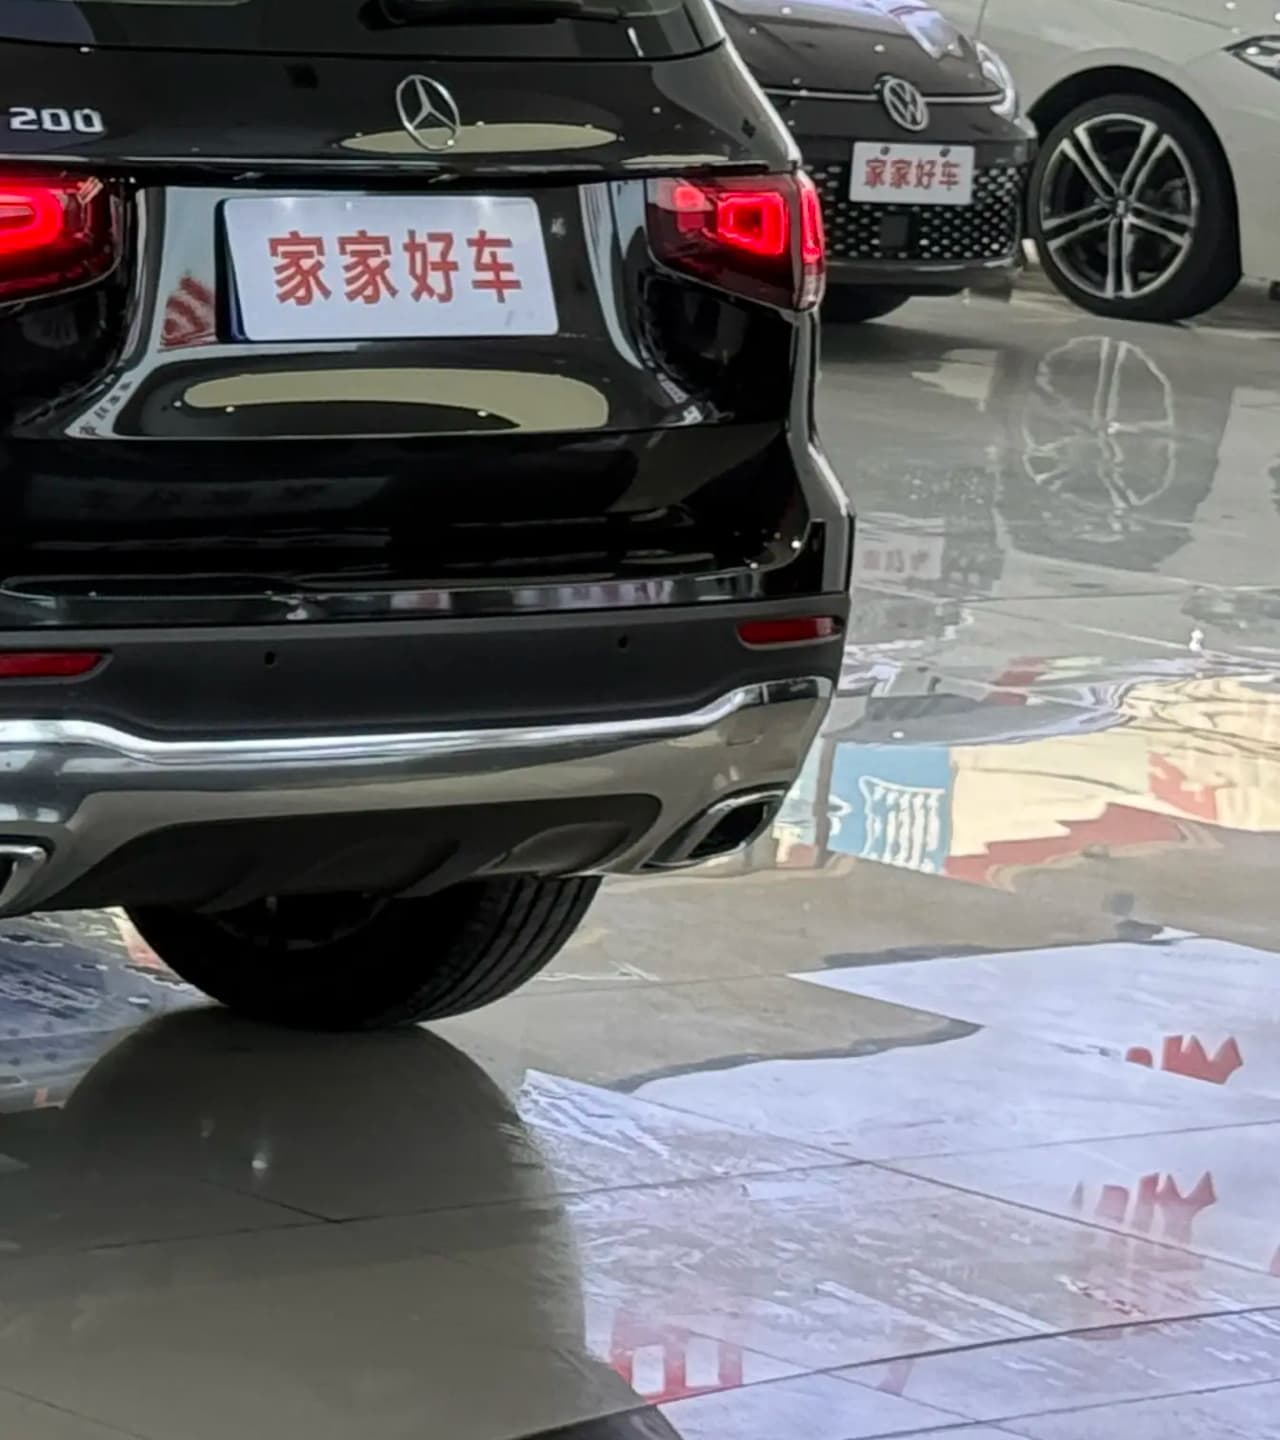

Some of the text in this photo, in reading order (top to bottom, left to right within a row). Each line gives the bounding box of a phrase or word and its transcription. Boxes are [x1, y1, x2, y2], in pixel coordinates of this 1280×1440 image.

[9, 107, 104, 133] 200
[864, 157, 960, 191] 家家好车
[267, 229, 522, 306] 家家好车
